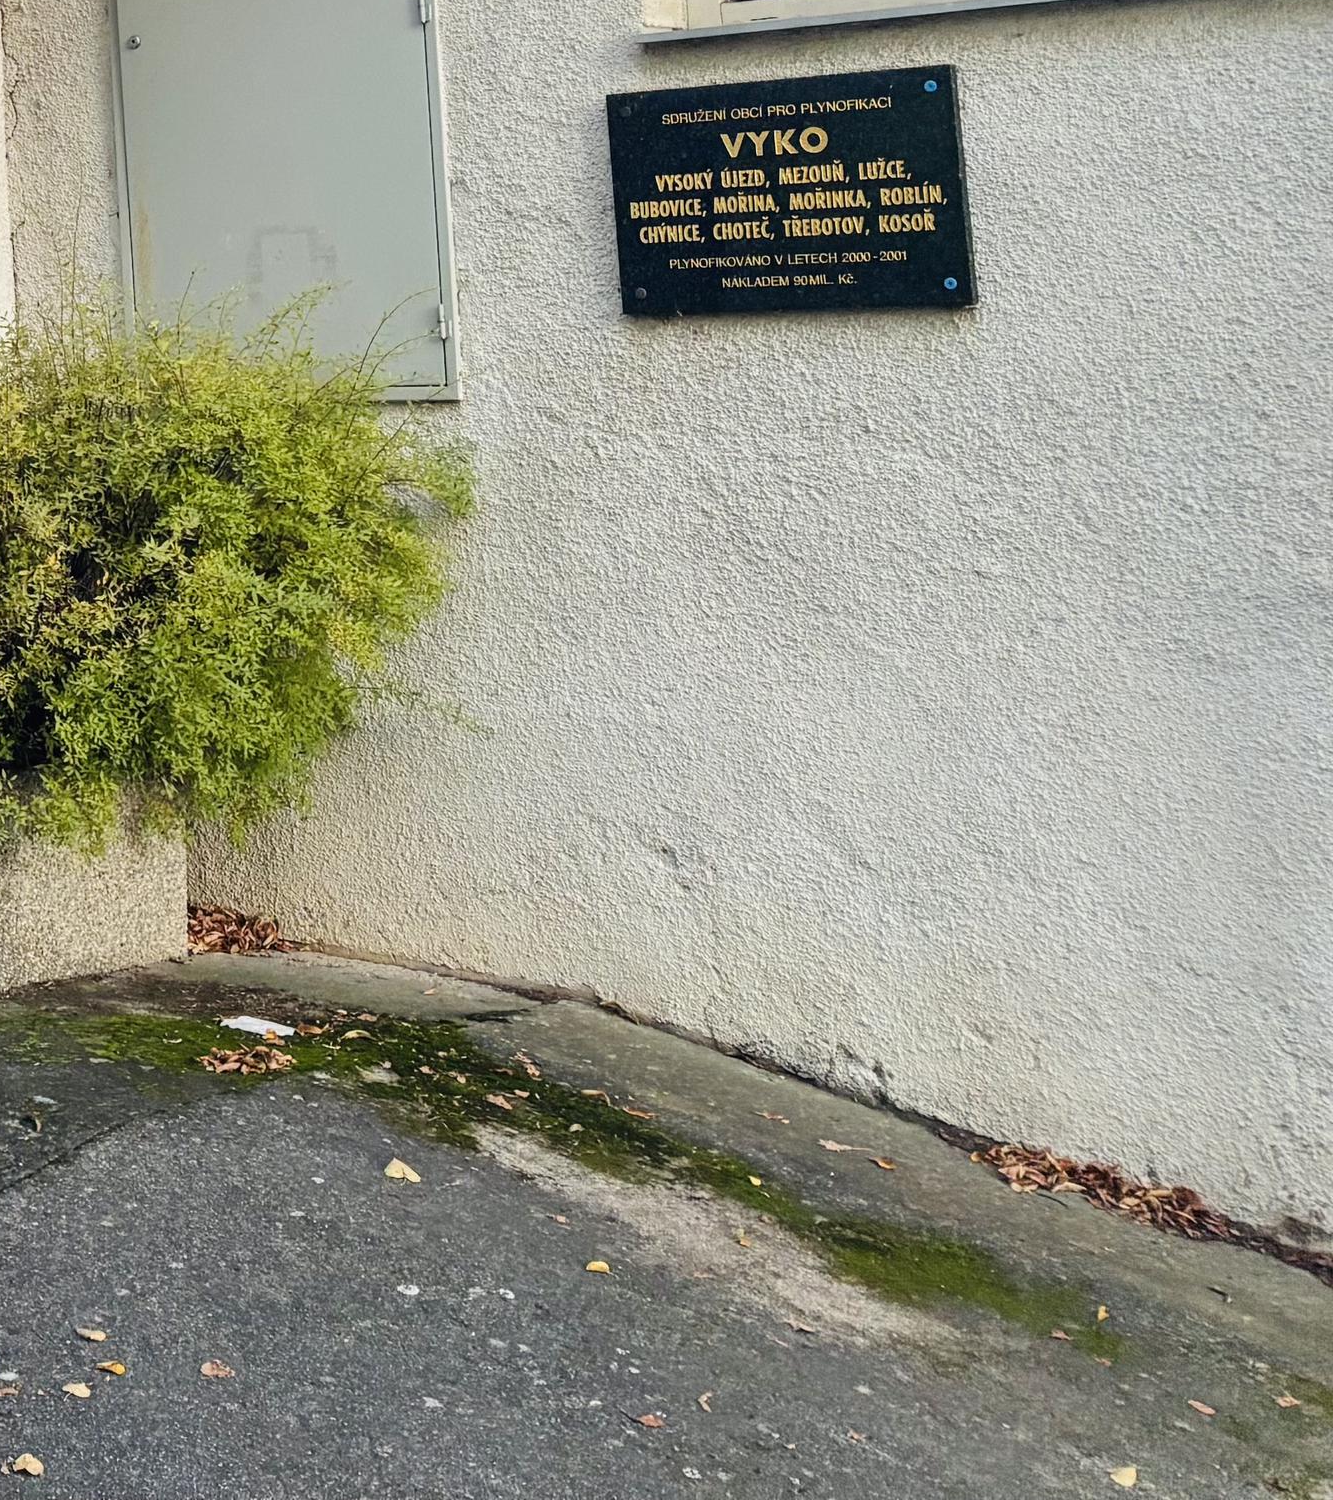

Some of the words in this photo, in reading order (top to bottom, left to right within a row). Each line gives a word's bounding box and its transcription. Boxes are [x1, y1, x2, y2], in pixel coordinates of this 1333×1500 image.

[661, 108, 726, 125] SDRUŽENÍ
[730, 104, 763, 120] OBCÍ
[767, 104, 796, 117] PRO
[720, 126, 829, 158] VYKO
[654, 168, 713, 192] VYSOKÝ
[720, 167, 771, 189] ÚJEZD,
[778, 159, 850, 186] MEZOUŇ,
[858, 157, 912, 181] LUŽCE,
[630, 196, 708, 220] BUBOVICE,
[713, 193, 780, 215] MOŘINA,
[789, 186, 872, 211] MOŘINKA,
[880, 180, 948, 206] ROBLÍN,
[639, 221, 706, 244] CHÝNICE,
[712, 216, 775, 241] CHOTEČ,
[783, 212, 870, 238] TŘEBOTOV,
[879, 208, 936, 233] KOSOŘ
[669, 253, 771, 270] PLYNOFIKOVÁNO
[774, 254, 783, 266] V
[788, 252, 837, 265] LETECH
[722, 272, 790, 289] NÁKLADEM
[838, 272, 857, 285] Kč.
